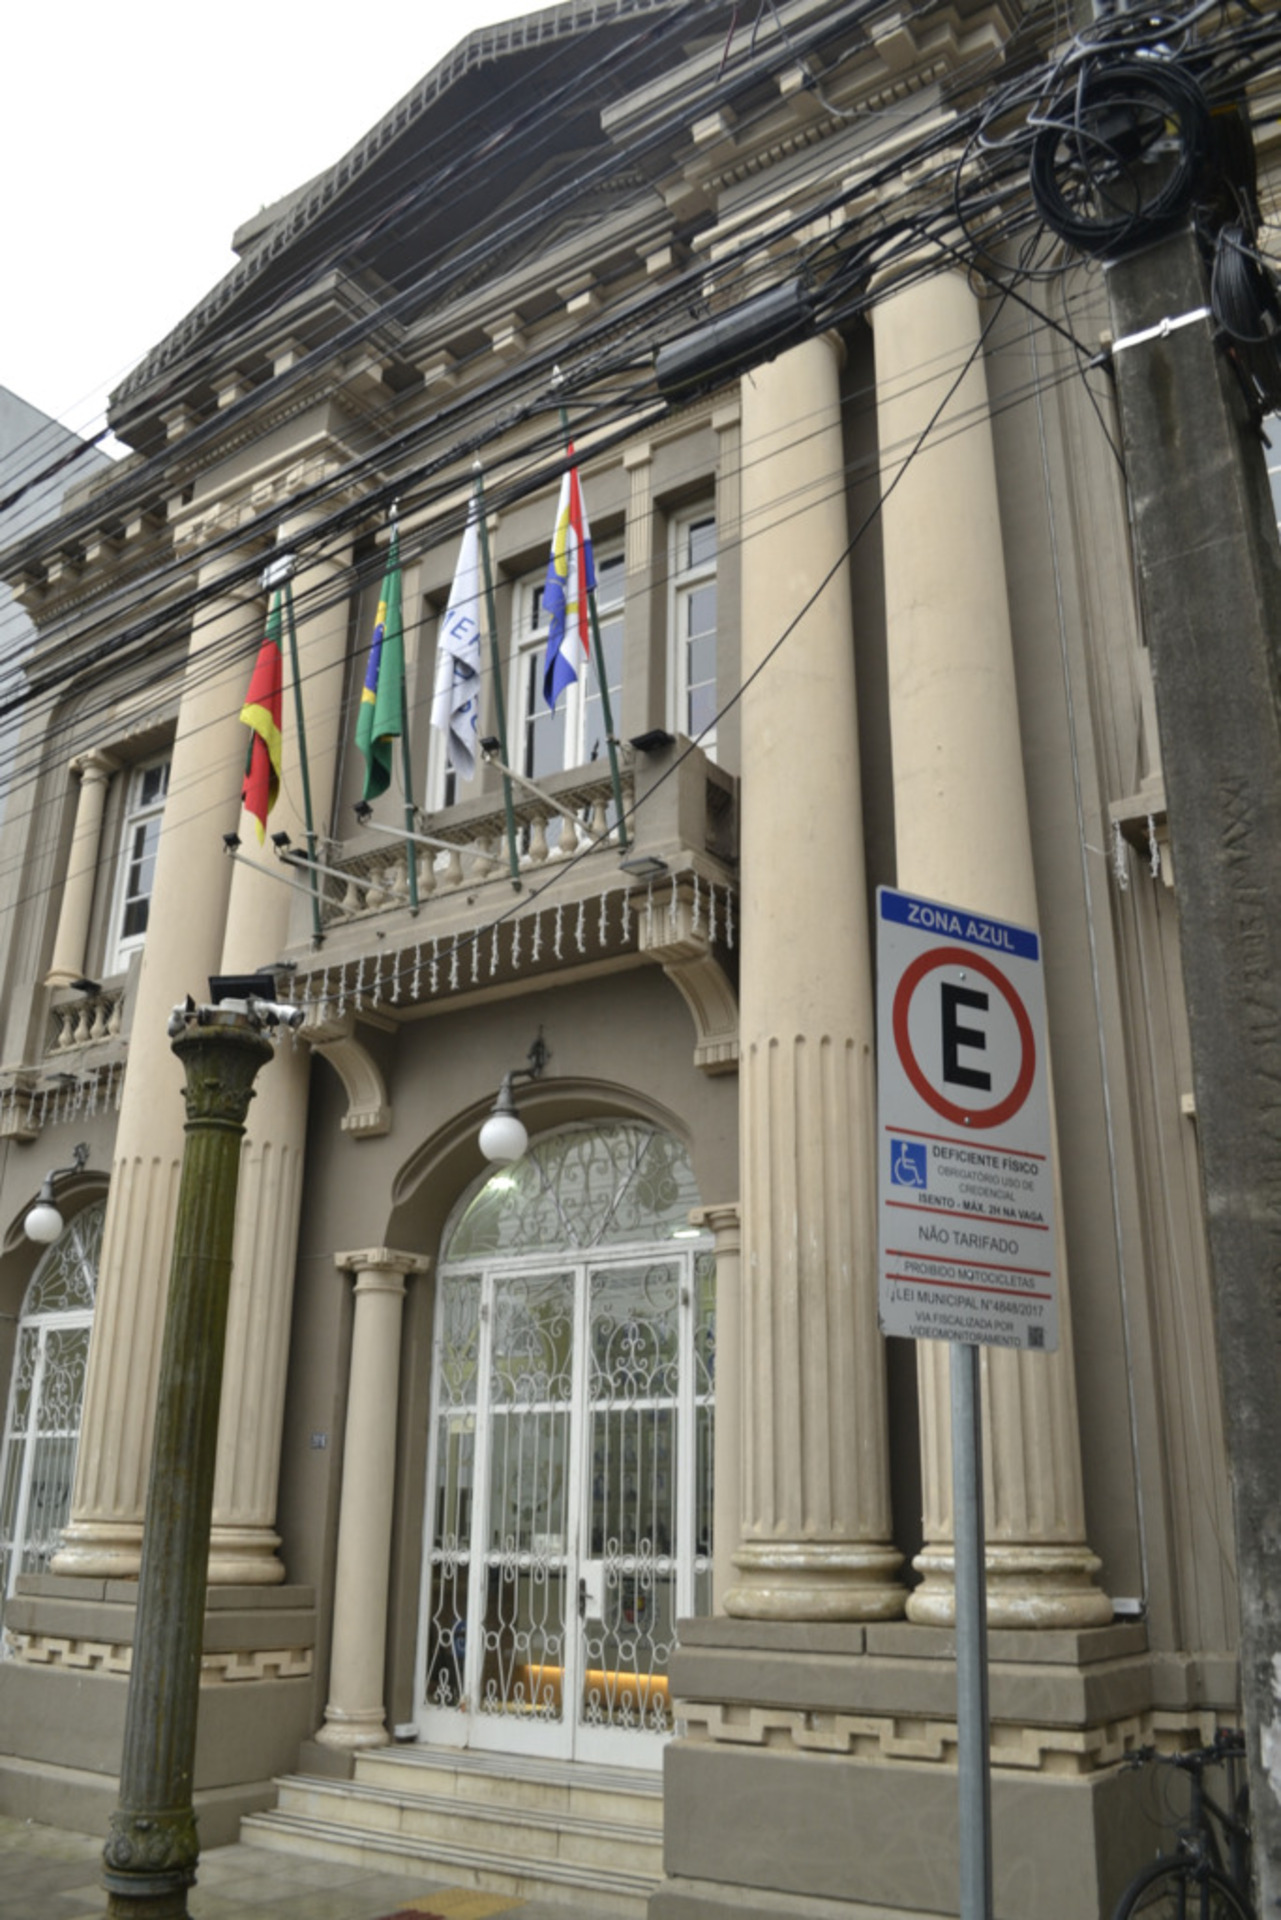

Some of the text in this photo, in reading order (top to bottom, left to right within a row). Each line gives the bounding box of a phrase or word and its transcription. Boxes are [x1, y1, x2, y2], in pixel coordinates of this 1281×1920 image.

[907, 903, 1015, 950] ZONA AZUL
[941, 981, 991, 1092] E
[932, 1145, 1039, 1176] DEFICIENTE FÍSICO
[937, 1165, 1035, 1192] OBRIGATÓRIO USO DE
[958, 1183, 1015, 1202] CREDENCIAL
[918, 1193, 955, 1208] ISENTO
[988, 1204, 1000, 1215] 2H
[1003, 1206, 1016, 1218] NA
[1017, 1209, 1044, 1222] VAGA
[918, 1224, 1020, 1256] NÃO TARIFADO
[904, 1260, 1036, 1290] PROIBIDO MOTOCICLETAS
[896, 1288, 915, 1301] LEI
[917, 1290, 980, 1311] MUNICIPAL
[909, 1325, 1021, 1347] VIDEOMONITORAMENTO
[914, 1311, 1014, 1332] VIA FISCALIZADA POR
